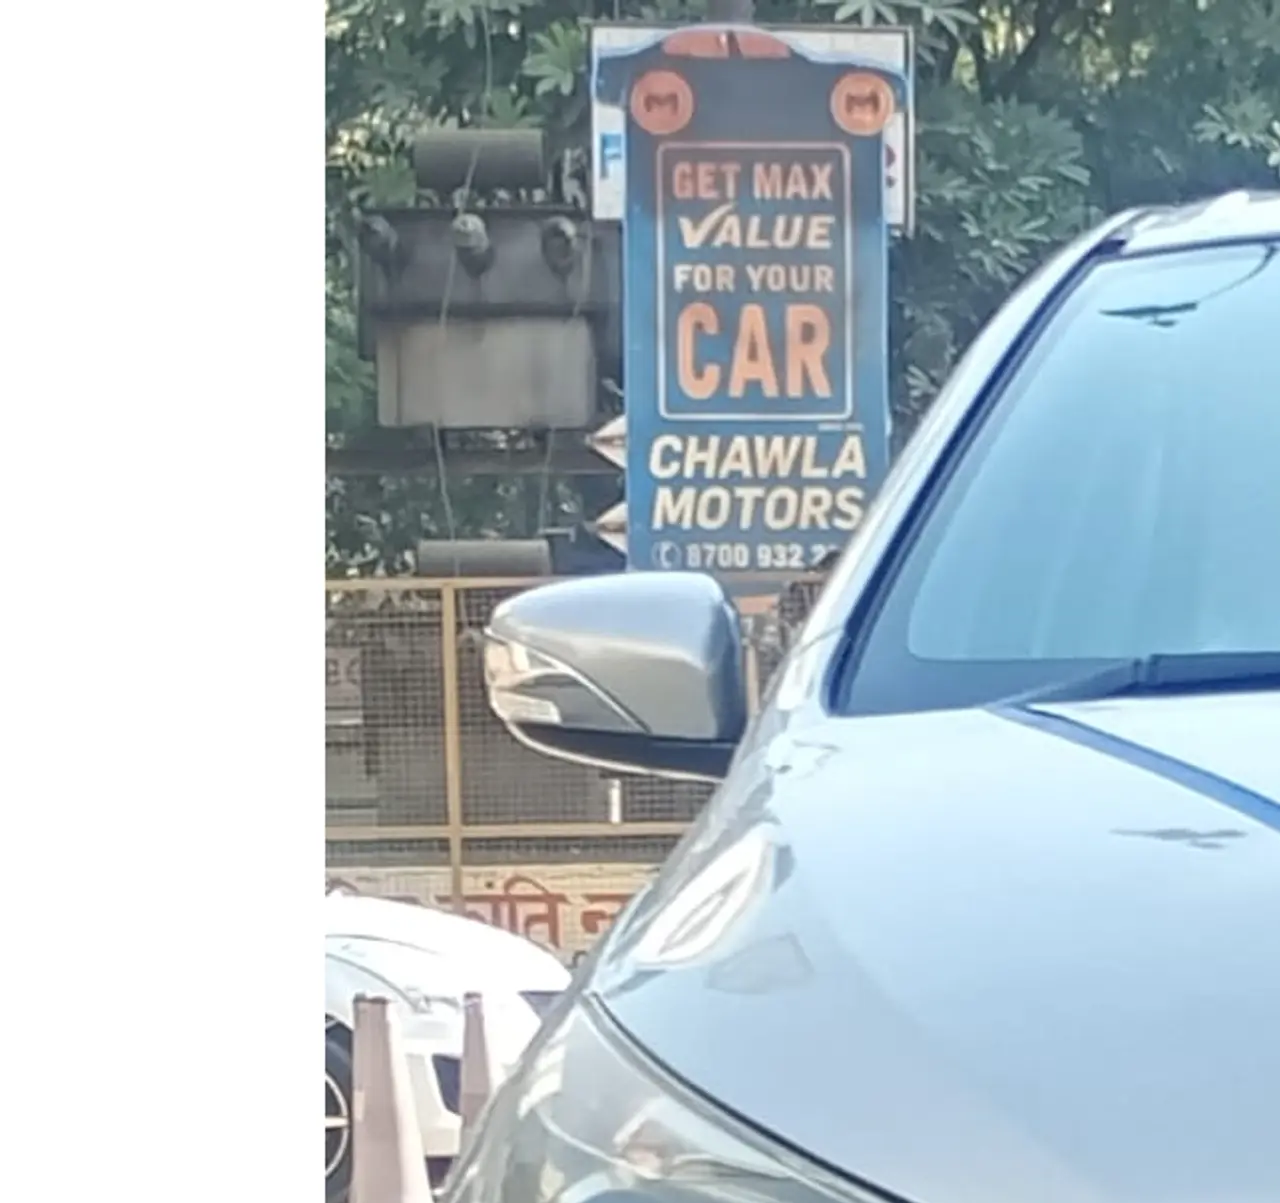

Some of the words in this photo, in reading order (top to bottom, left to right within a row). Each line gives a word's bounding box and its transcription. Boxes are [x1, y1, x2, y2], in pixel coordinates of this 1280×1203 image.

[673, 161, 741, 199] GET
[753, 162, 833, 200] MAX
[678, 202, 836, 249] VALUE
[673, 264, 736, 293] FOR
[745, 264, 834, 293] YOUR
[677, 302, 832, 399] CAR
[649, 434, 867, 479] CHAWLA
[651, 486, 866, 531] MOTORS
[686, 543, 748, 568] 8700
[757, 543, 804, 568] 932
